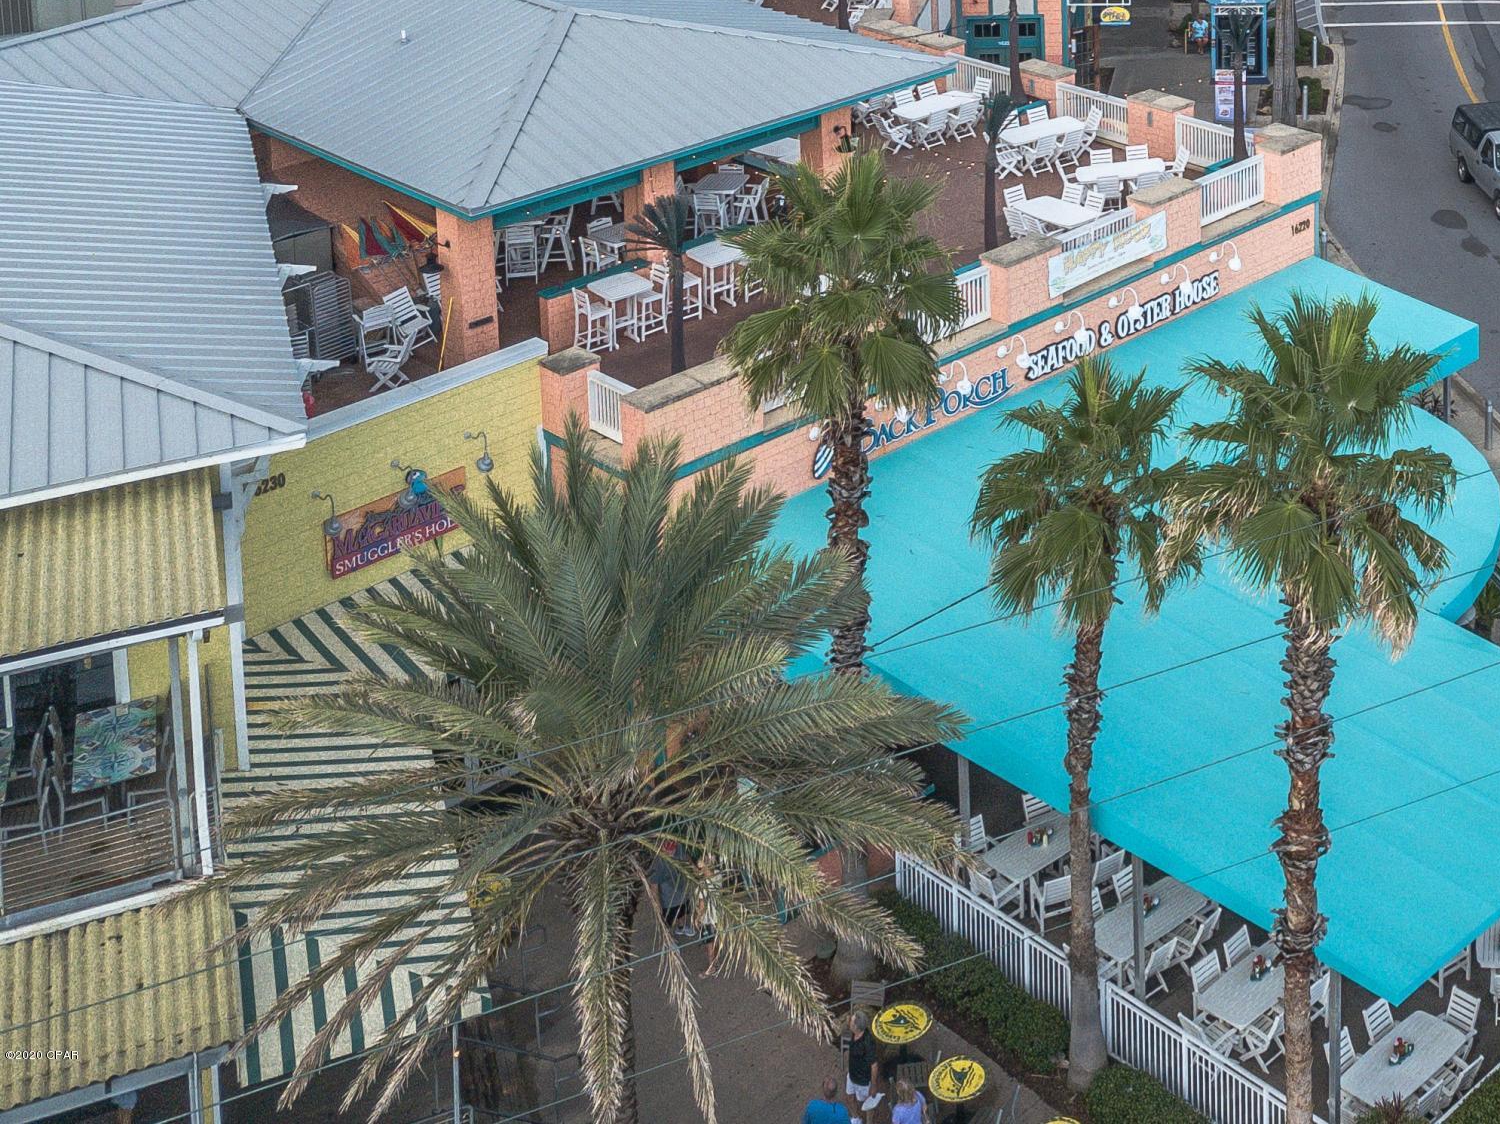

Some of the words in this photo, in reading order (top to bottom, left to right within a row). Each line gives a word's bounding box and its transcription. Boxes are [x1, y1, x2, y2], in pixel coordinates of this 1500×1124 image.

[1290, 218, 1311, 237] 16220
[1025, 328, 1096, 381] SEAFOOD
[1098, 320, 1115, 348] &
[1116, 293, 1172, 339] OYSTER
[1172, 270, 1220, 314] HOUSE
[922, 366, 1015, 428] PORCH
[334, 529, 424, 576] SMUGGLER'S
